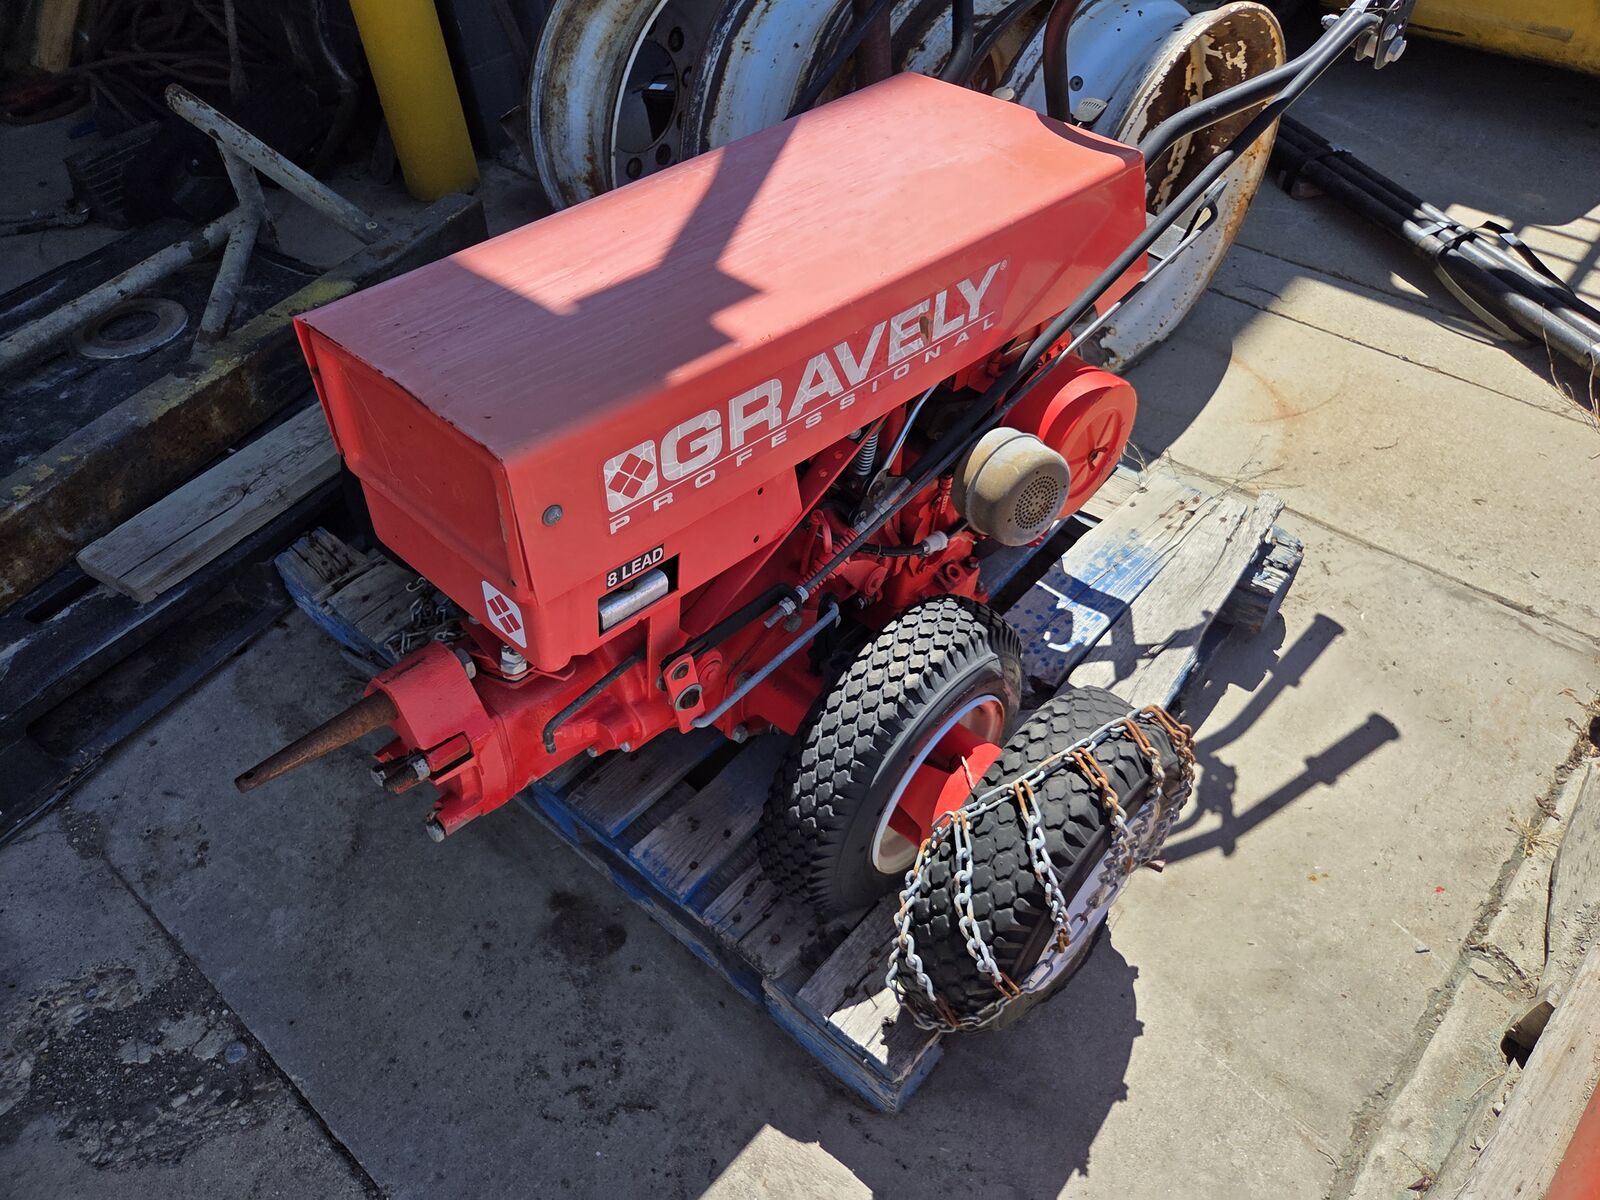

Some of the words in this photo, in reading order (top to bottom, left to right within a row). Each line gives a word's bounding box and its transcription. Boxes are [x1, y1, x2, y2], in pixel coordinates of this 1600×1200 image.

[609, 319, 995, 535] PROFESSIONAL
[660, 261, 1001, 482] GRAVELY
[607, 572, 618, 587] 8
[622, 547, 664, 580] LEAD
